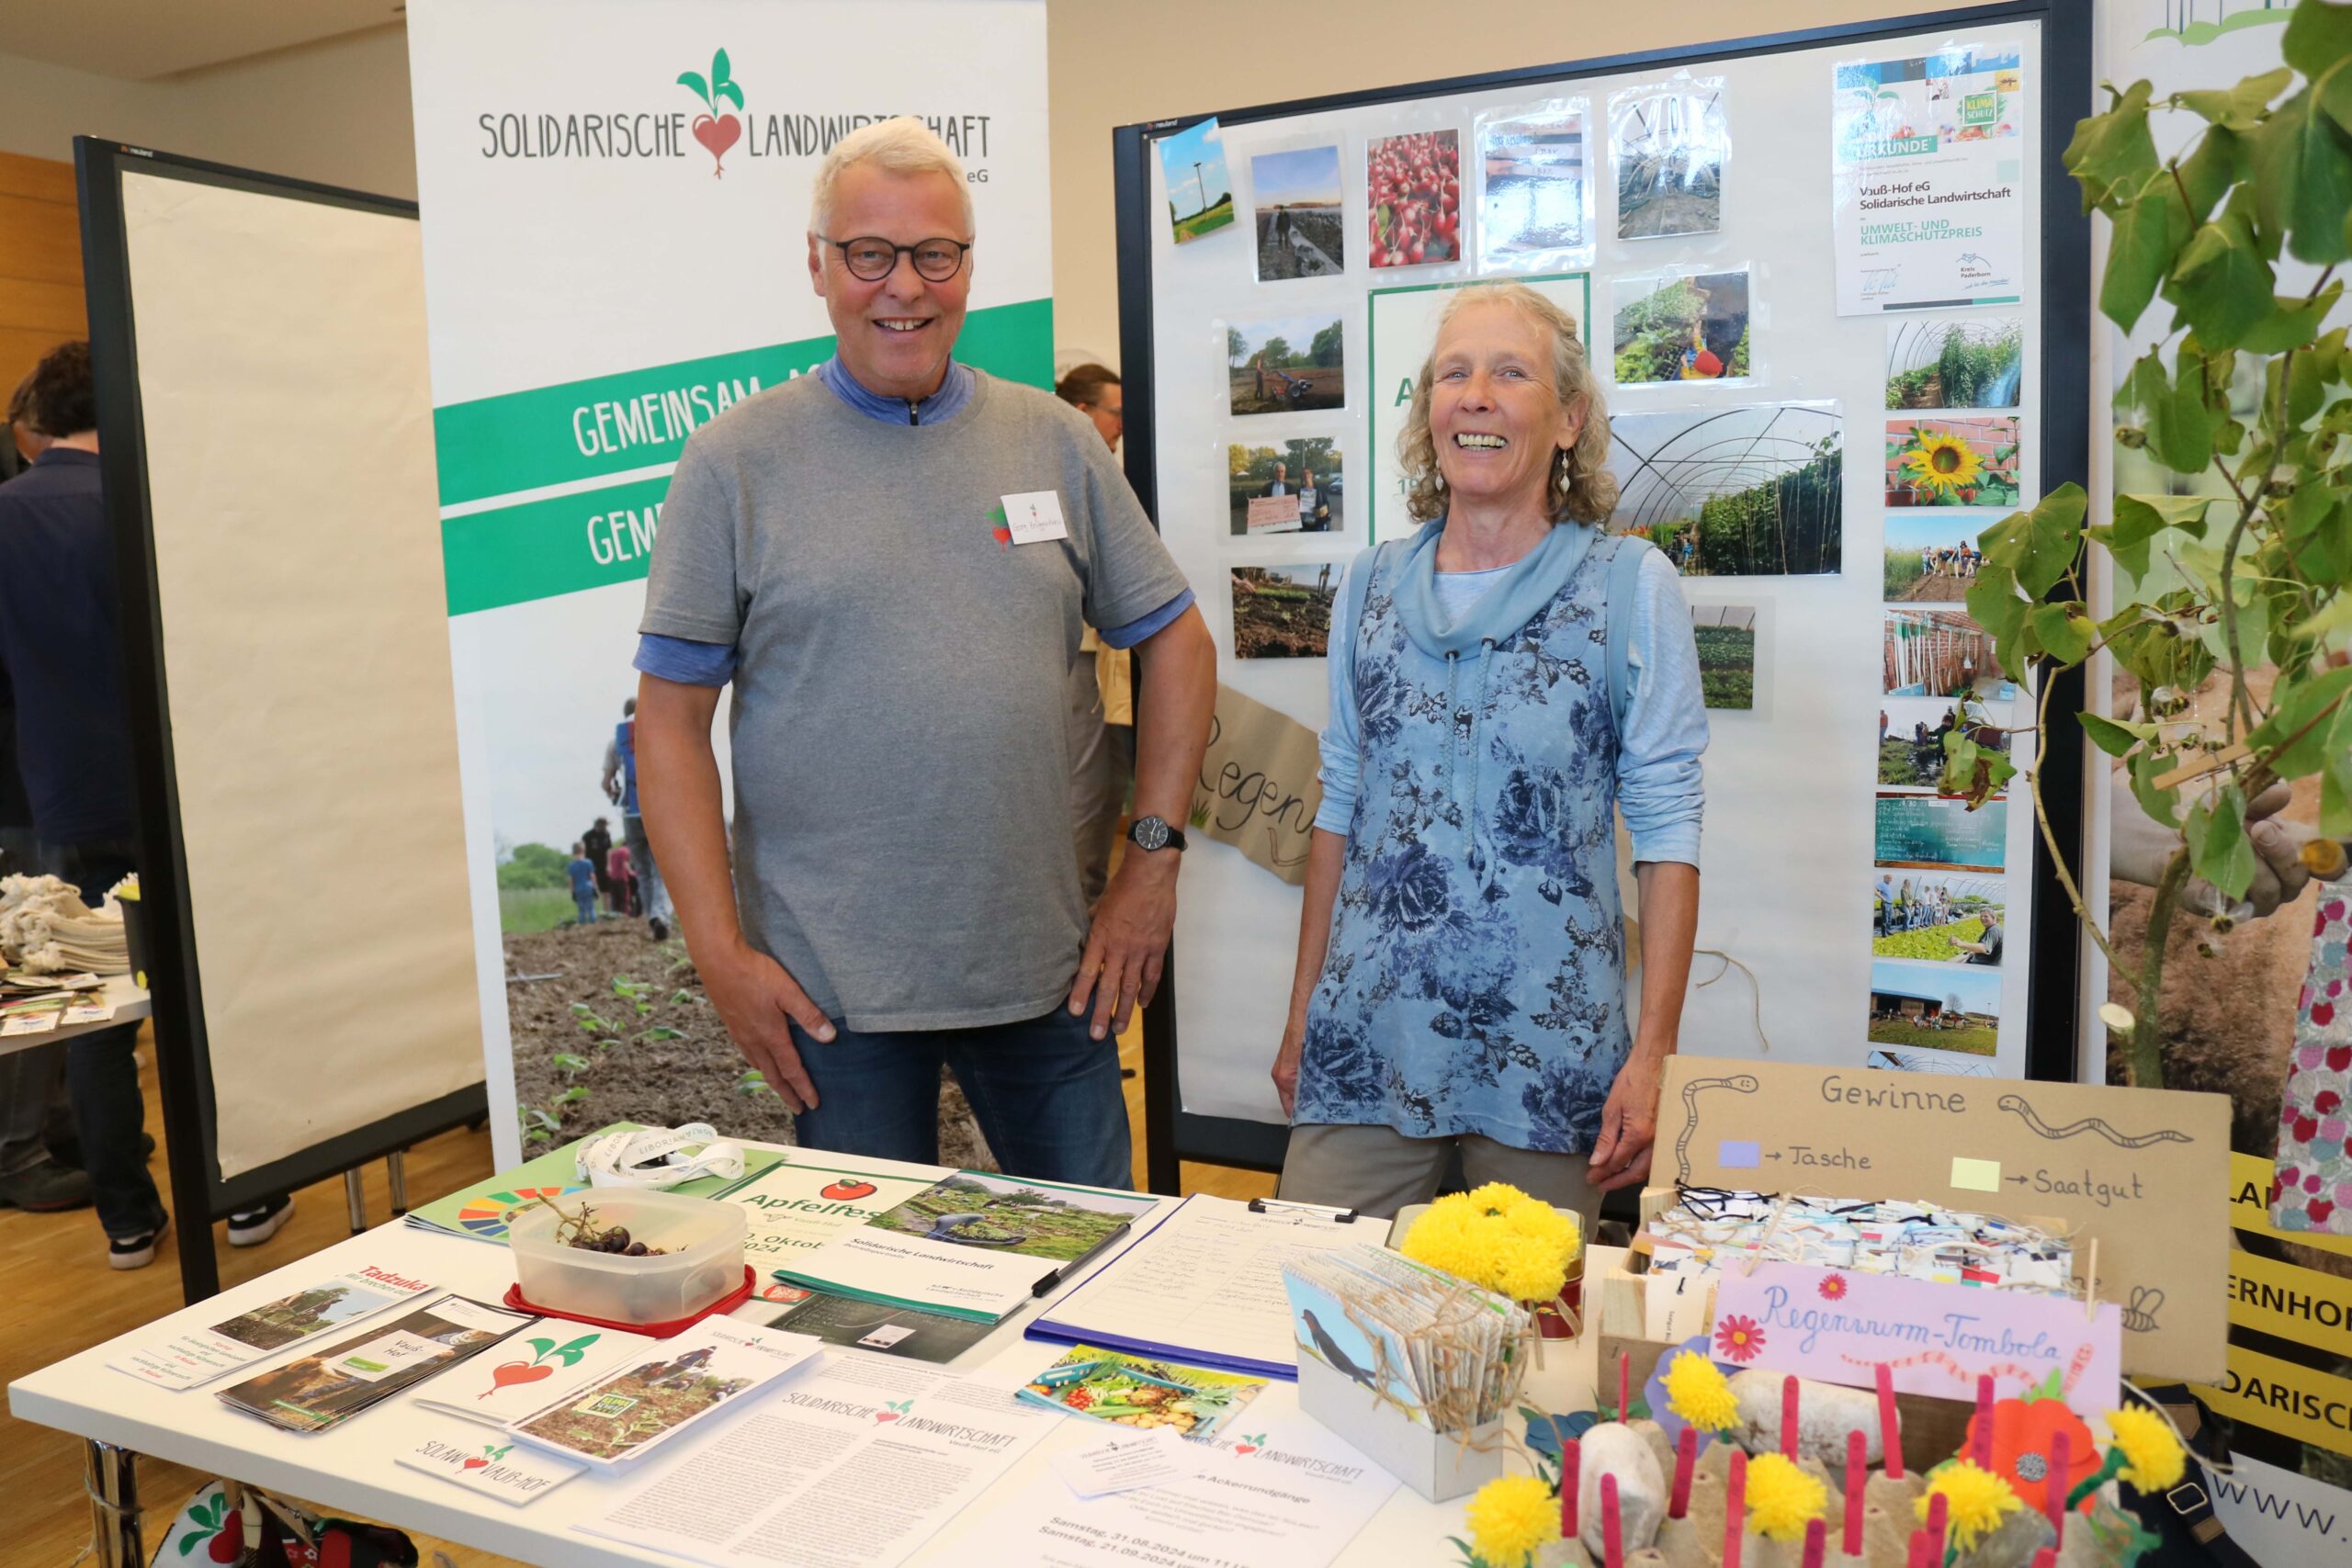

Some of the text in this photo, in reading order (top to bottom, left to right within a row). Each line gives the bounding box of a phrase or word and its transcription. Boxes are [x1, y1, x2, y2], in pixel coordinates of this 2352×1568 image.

[479, 113, 991, 158] SOLIDARISCHE LANDWIHAFT
[967, 169, 989, 183] eG
[1915, 181, 1930, 192] eG
[1860, 186, 2012, 210] Solidarische Landwirtschaft
[1860, 219, 1951, 236] UMWELT- UND
[1860, 226, 1984, 246] KLIMASCHUTZPREIS
[587, 502, 665, 565] GEM
[1821, 1075, 1967, 1114] Gewinne
[1788, 1145, 1872, 1170] Tasche
[2034, 1168, 2143, 1208] Saatgut
[851, 1237, 995, 1270] Solidarische Landwirtschaft
[358, 1265, 429, 1292] Tadzuka
[2227, 1274, 2352, 1332] ERNHO
[382, 1348, 407, 1359] Hof
[2221, 1370, 2352, 1432] DARISC
[782, 1391, 1018, 1449] SOLIDARISCHE LANDWIRTSCHAFT
[415, 1440, 470, 1465] SOLAWI
[1253, 1448, 1365, 1480] LANDWIRTSCHAFT
[1207, 1474, 1311, 1505] Ackerrundgänge
[1038, 1526, 1097, 1548] Samstag,
[1099, 1540, 1176, 1568] 21.09.2024
[1049, 1516, 1108, 1539] Samstag,
[1110, 1532, 1187, 1558] 31.08.2024
